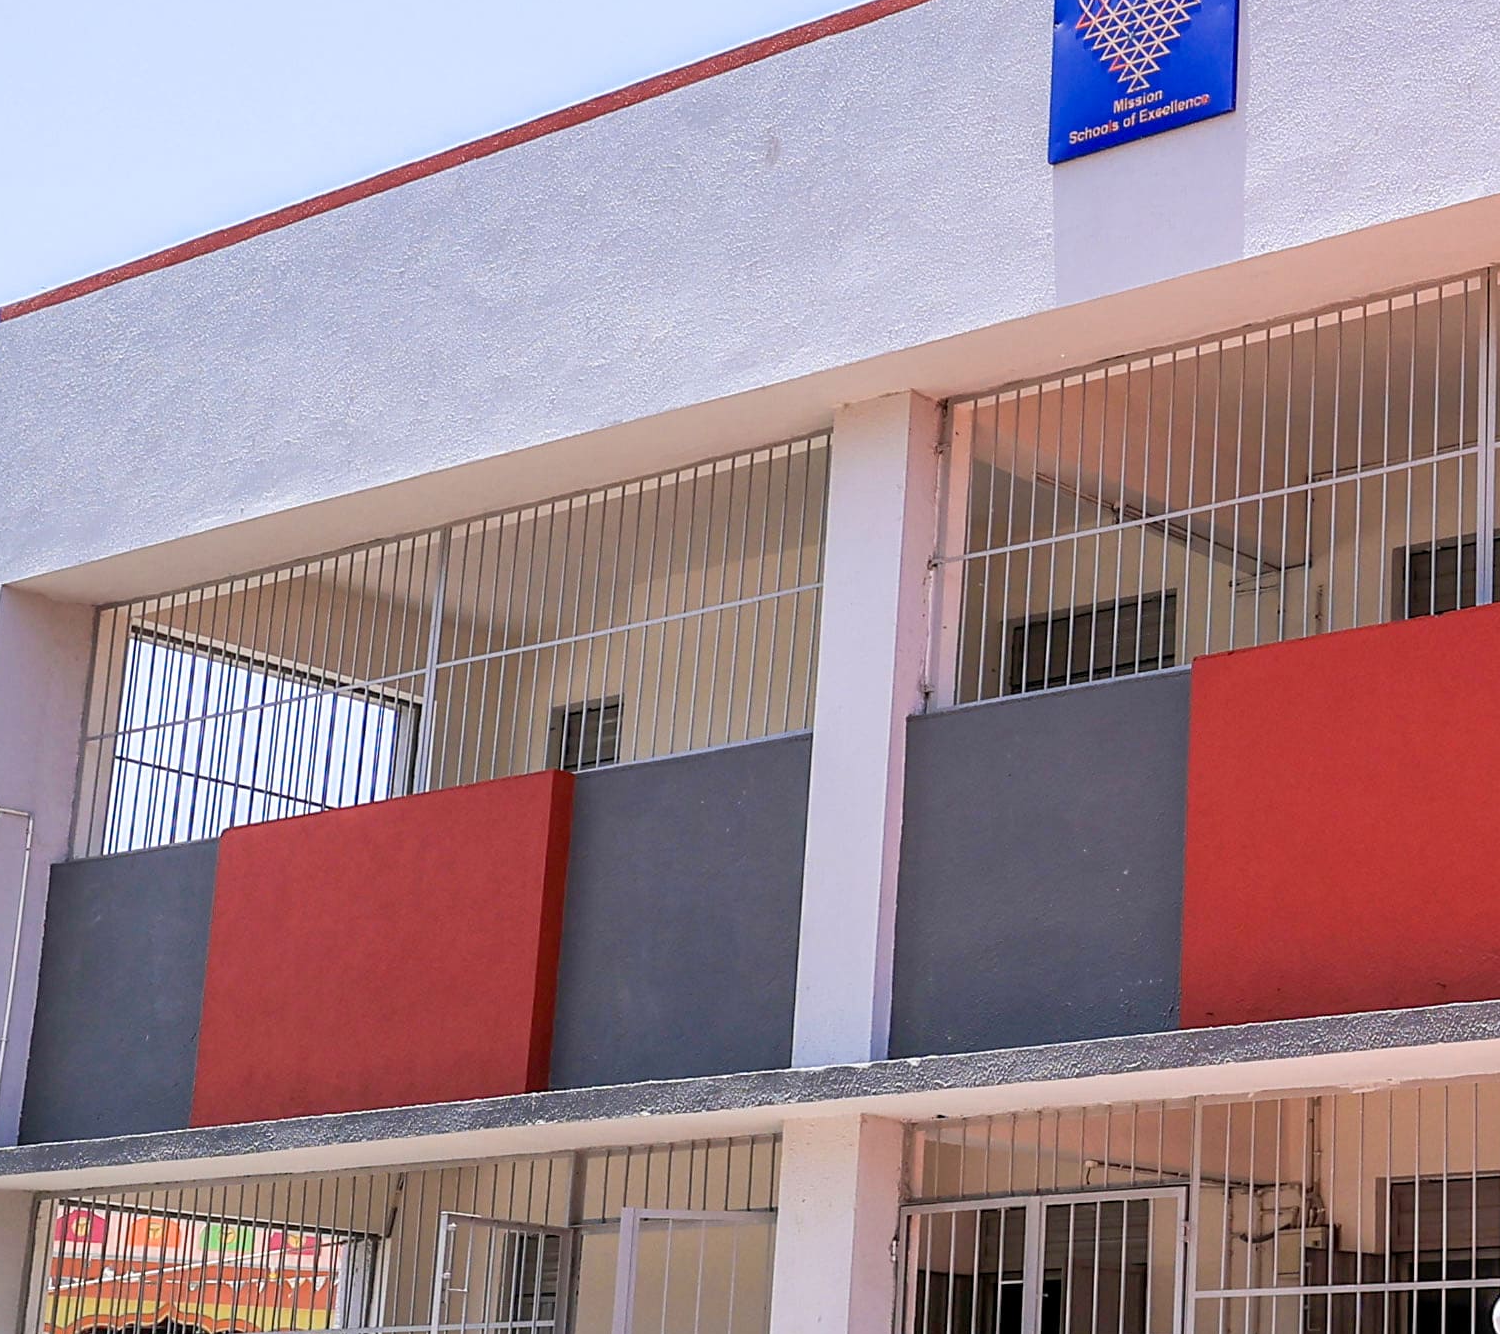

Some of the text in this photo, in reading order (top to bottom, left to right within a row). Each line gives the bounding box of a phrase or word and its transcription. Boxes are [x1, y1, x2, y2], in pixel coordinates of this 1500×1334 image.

[1069, 94, 1210, 144] Schools of Excellence
[1113, 90, 1163, 113] Mission
